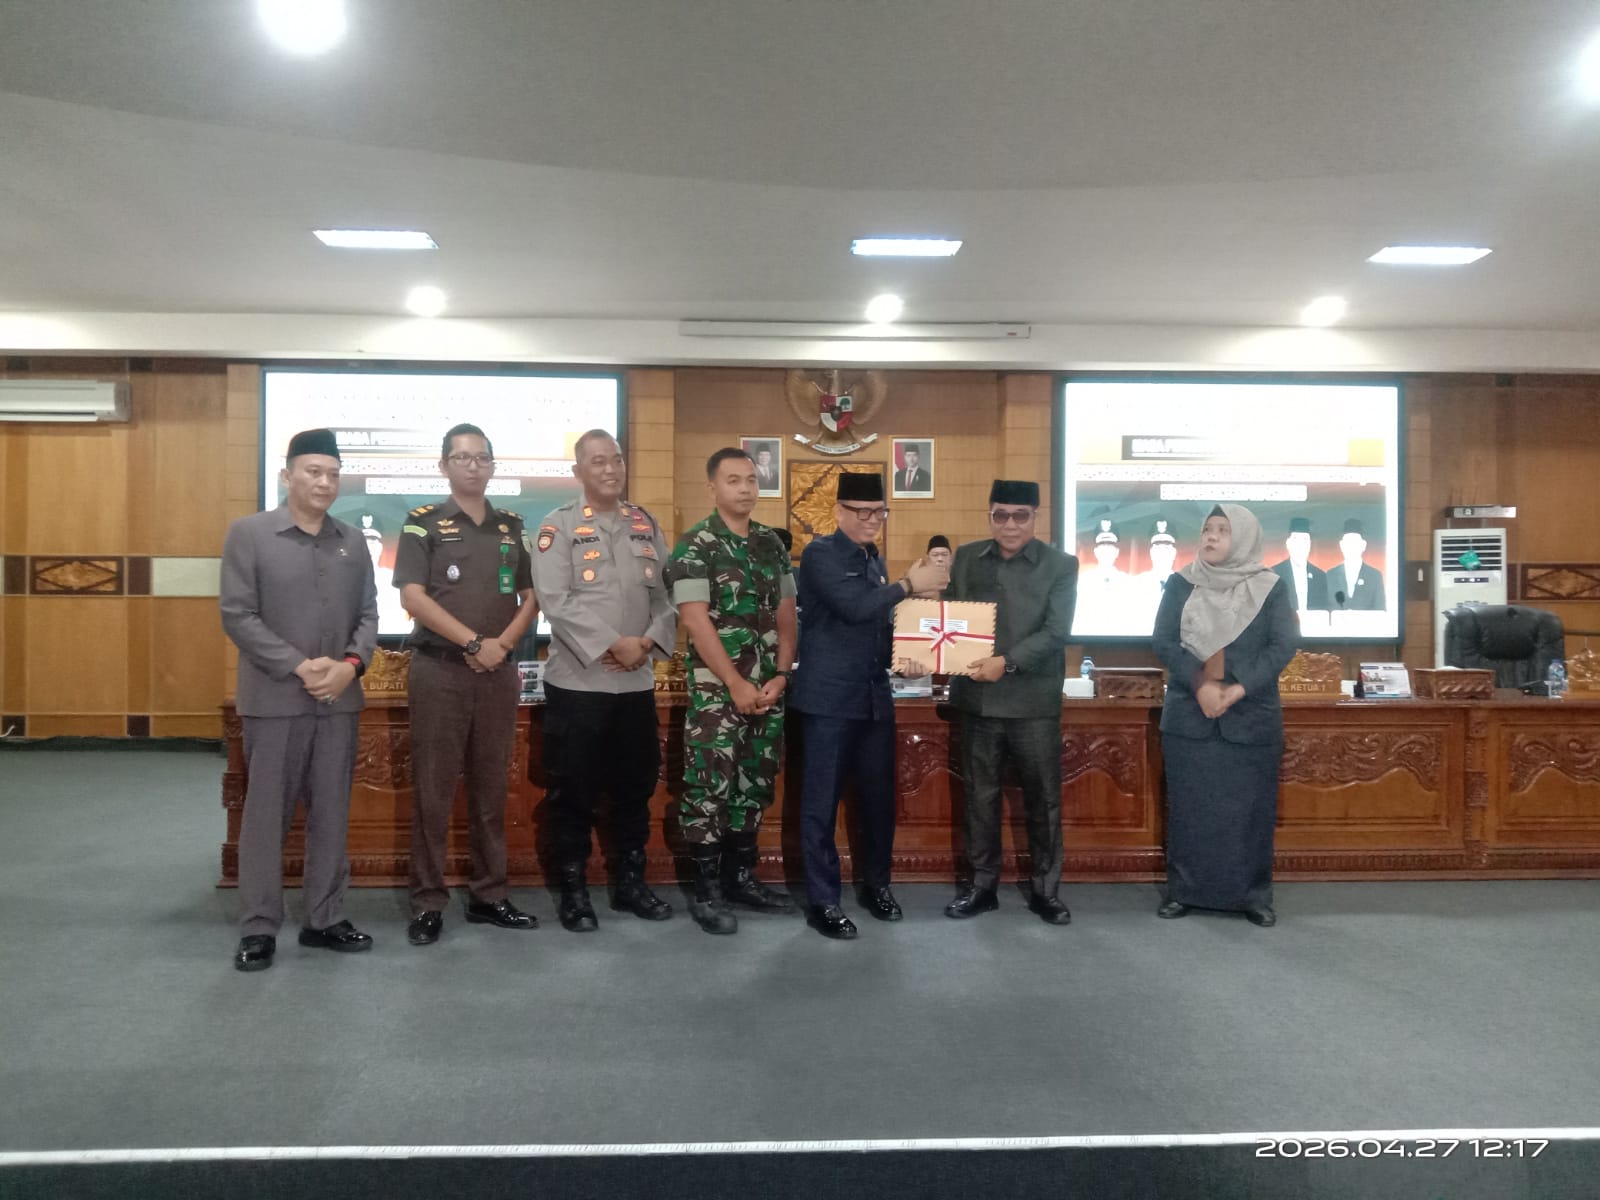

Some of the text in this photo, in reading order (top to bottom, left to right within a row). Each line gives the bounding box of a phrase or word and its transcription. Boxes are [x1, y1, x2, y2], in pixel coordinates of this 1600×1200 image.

[572, 536, 600, 546] ANDI
[655, 682, 684, 691] PATI
[1291, 683, 1319, 691] KETUA
